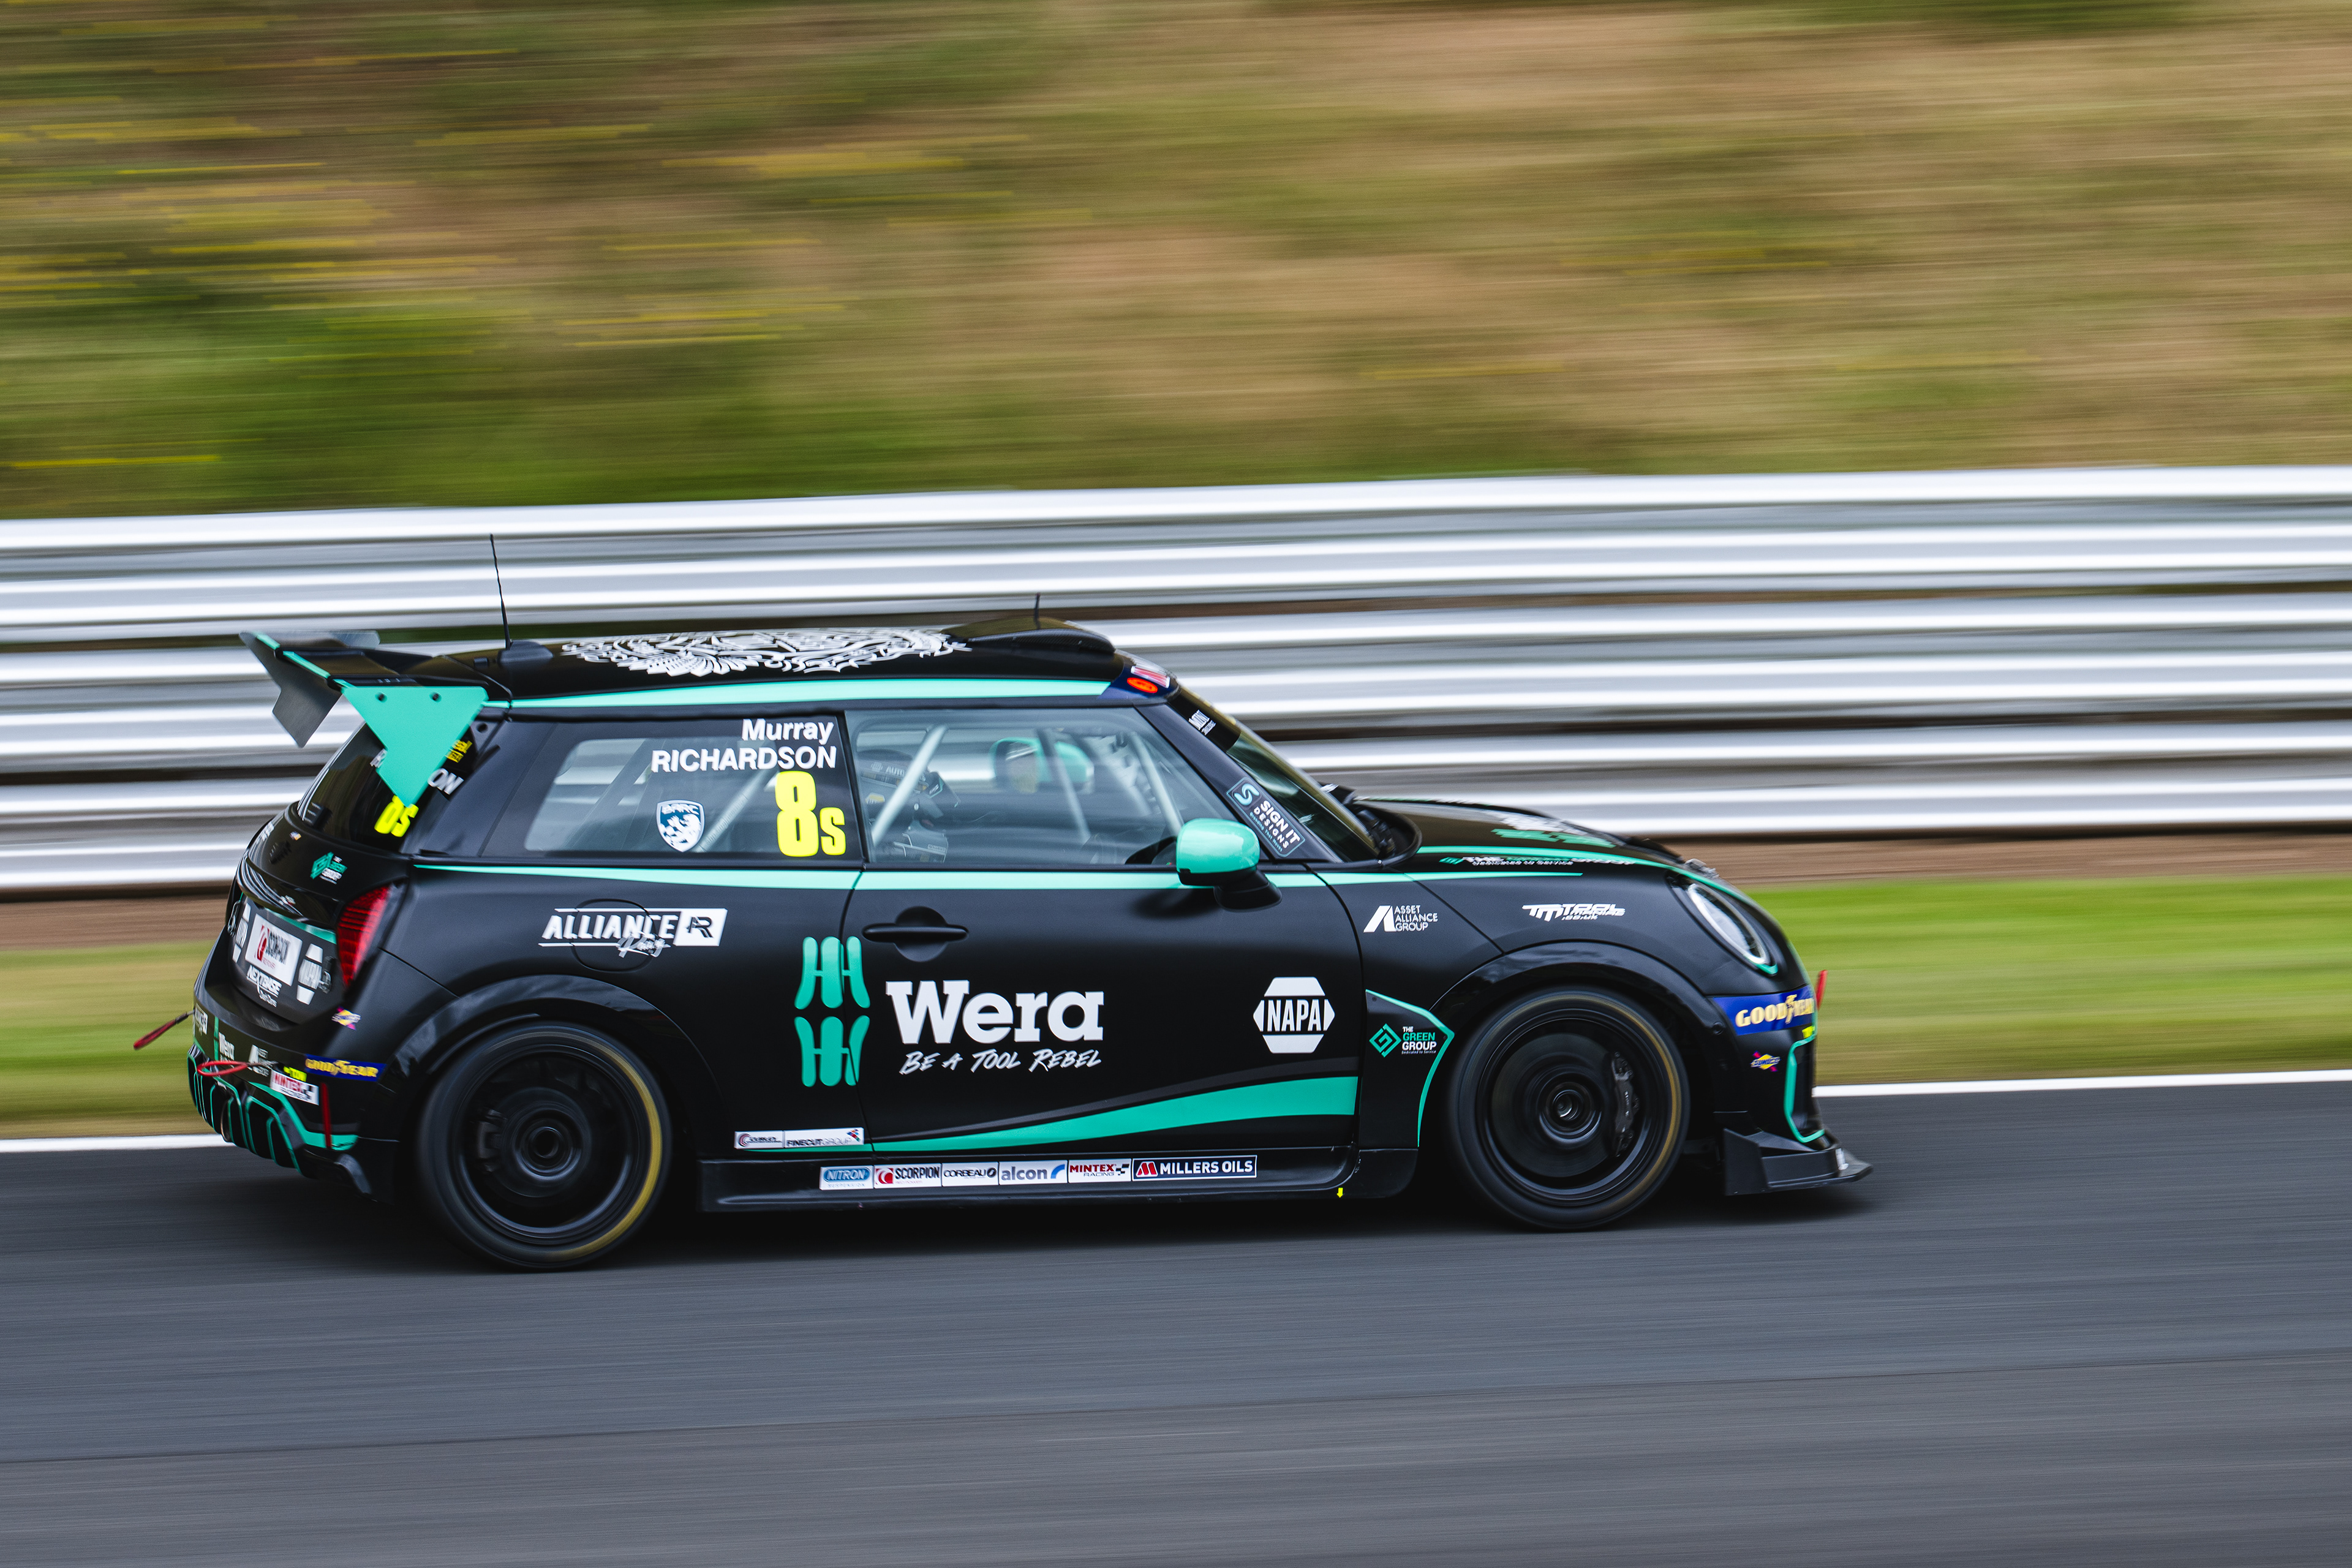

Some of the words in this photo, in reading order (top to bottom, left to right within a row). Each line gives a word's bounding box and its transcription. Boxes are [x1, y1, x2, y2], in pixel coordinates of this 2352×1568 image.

[742, 718, 834, 745] Murray
[651, 745, 837, 772] RICHARDSON
[1254, 807, 1289, 848] DESIGNS
[1261, 801, 1289, 832] SIGN
[1286, 829, 1300, 843] IT
[1394, 905, 1420, 914] ASSET
[1395, 913, 1438, 922] ALLIANCE
[541, 914, 678, 939] ALLIANCE
[1395, 922, 1429, 932] GROUP
[886, 980, 1104, 1044] Wera
[1267, 999, 1322, 1031] NAPA
[1403, 1032, 1436, 1041] GREEN
[1402, 1041, 1437, 1051] GROUP
[899, 1050, 941, 1074] BE
[941, 1053, 963, 1071] A
[970, 1049, 1021, 1073] TOOL
[1028, 1049, 1102, 1072] REBEL
[827, 1169, 865, 1180] NITRON
[895, 1166, 940, 1180] SCORPION
[943, 1169, 986, 1178] CORBEAU
[1001, 1166, 1048, 1181] alcon
[1069, 1164, 1114, 1173] MINTEX
[1160, 1161, 1219, 1175] MILLERS
[1222, 1160, 1253, 1173] OILS
